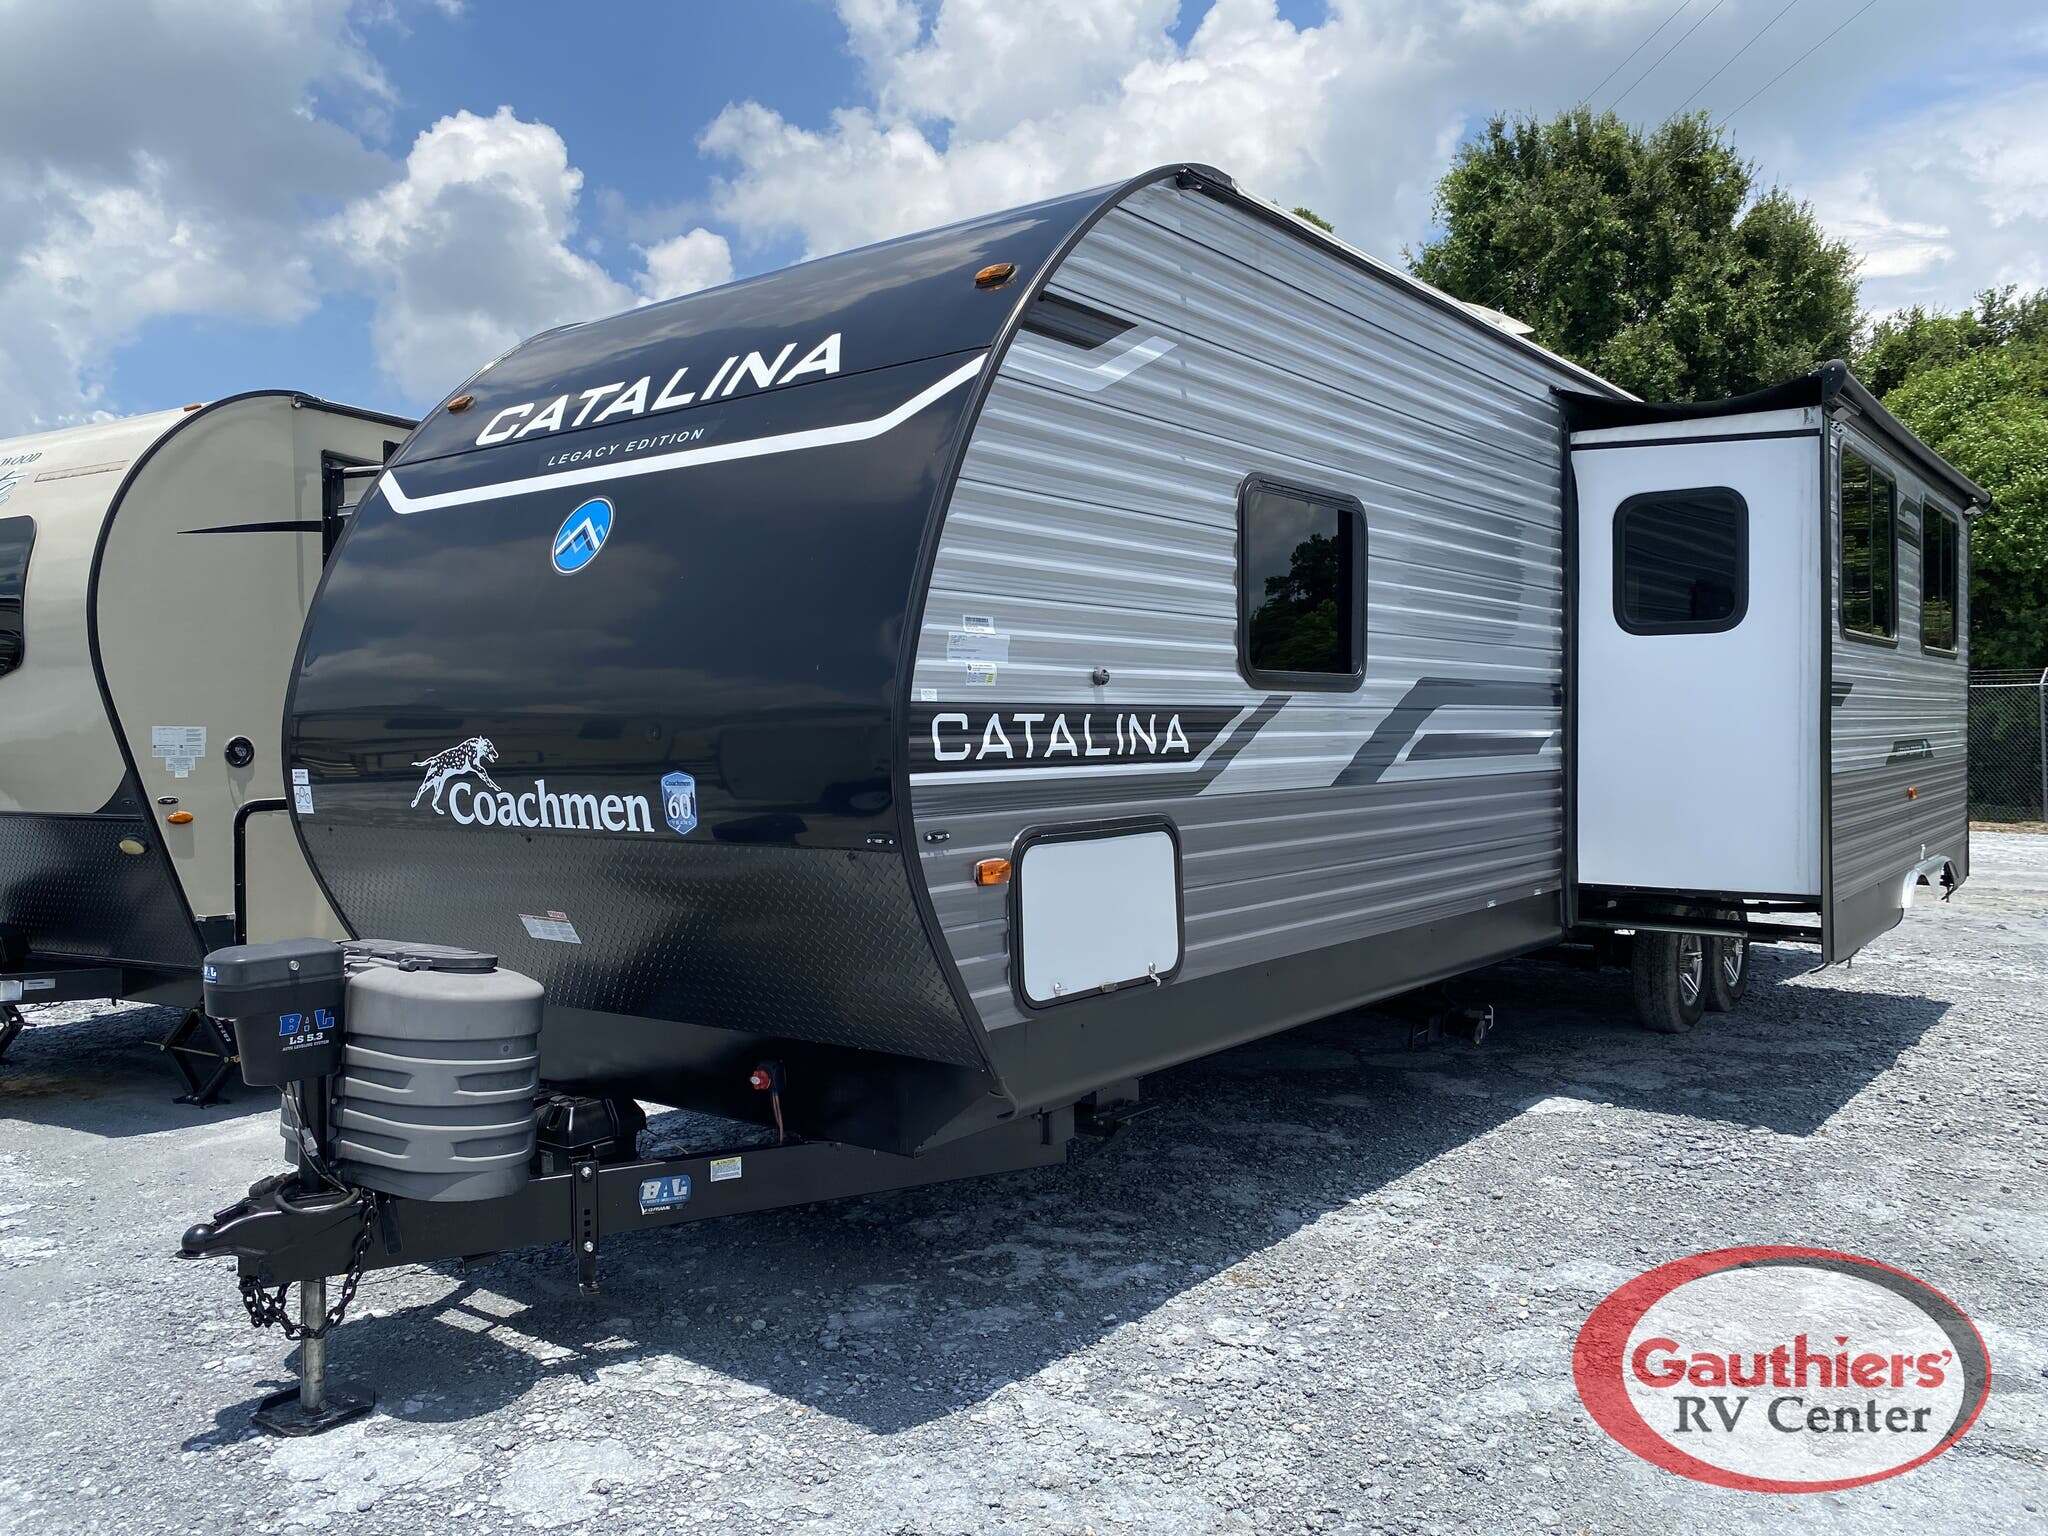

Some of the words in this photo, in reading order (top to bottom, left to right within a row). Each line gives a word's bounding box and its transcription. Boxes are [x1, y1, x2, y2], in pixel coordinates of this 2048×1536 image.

[475, 332, 842, 446] CATALINA
[547, 443, 620, 467] LEGACY
[625, 428, 705, 453] EDITION
[931, 713, 1190, 761] CATALINA
[449, 779, 655, 833] Coachmen
[668, 793, 691, 819] 60
[289, 1036, 305, 1045] LS
[307, 1032, 323, 1042] 5.3
[641, 1178, 688, 1200] BAL
